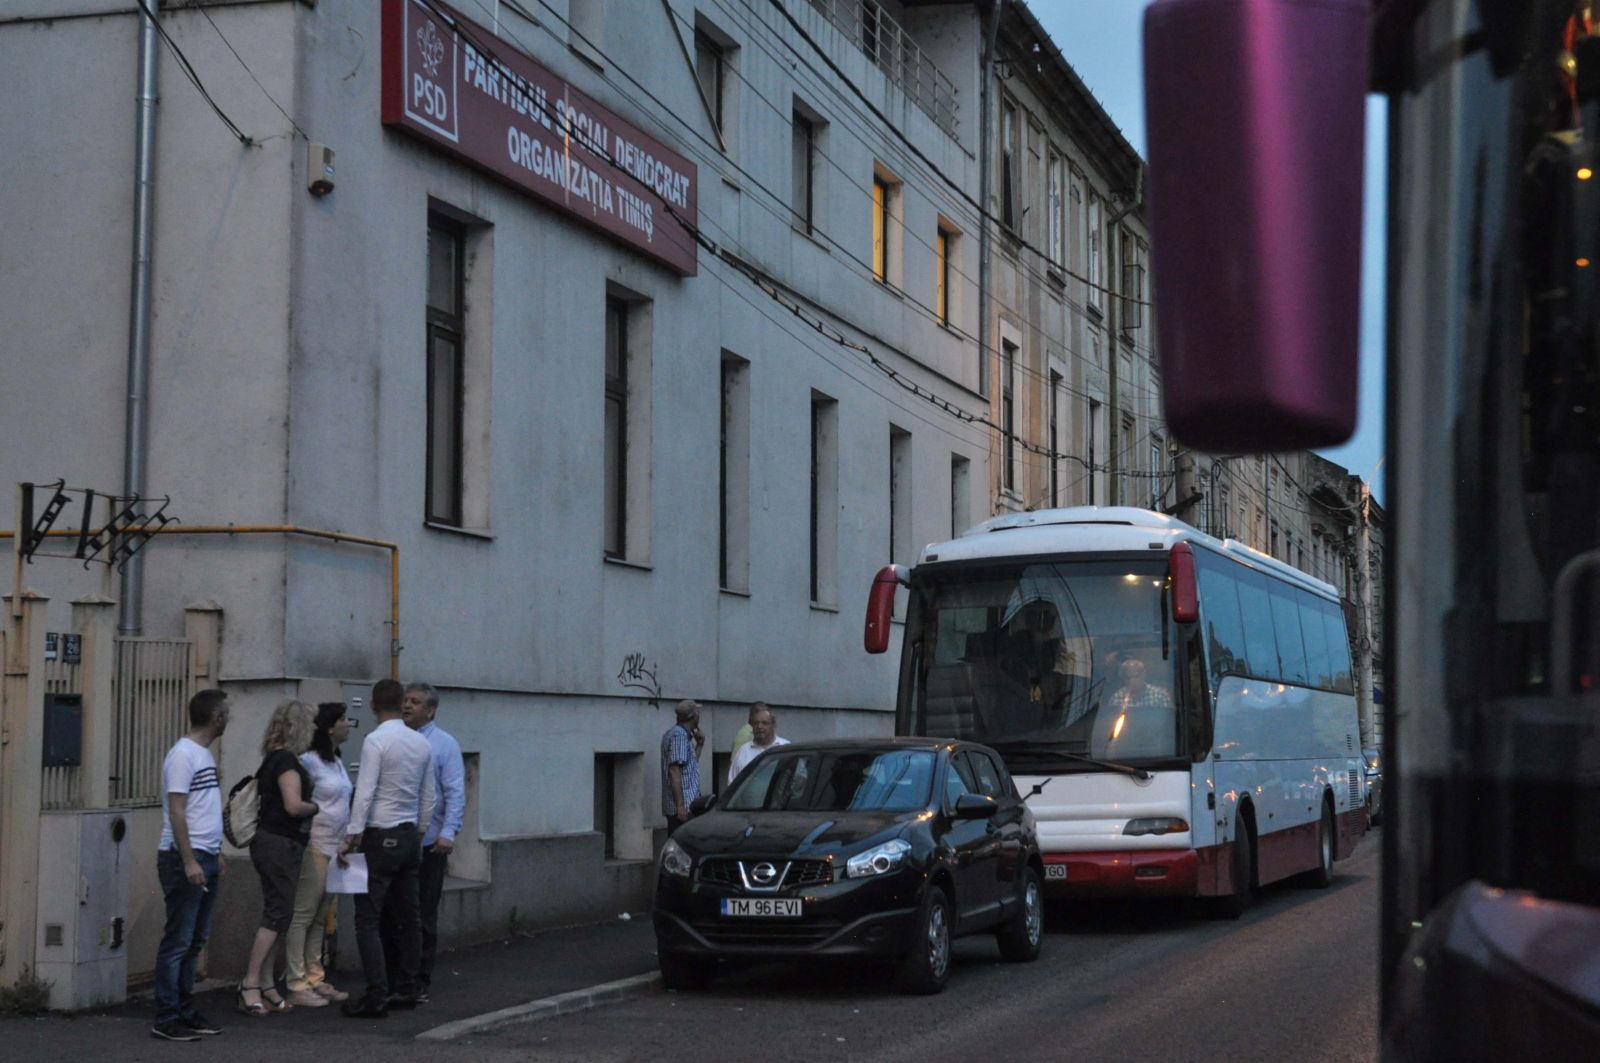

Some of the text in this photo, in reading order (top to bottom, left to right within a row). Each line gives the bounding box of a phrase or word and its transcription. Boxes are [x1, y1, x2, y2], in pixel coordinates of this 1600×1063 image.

[413, 72, 447, 121] PSD
[463, 42, 690, 209] PARTIDUL SOCIAL DEMOCRAT
[730, 900, 750, 914] TM
[754, 900, 772, 914] 96
[774, 900, 799, 915] EVI
